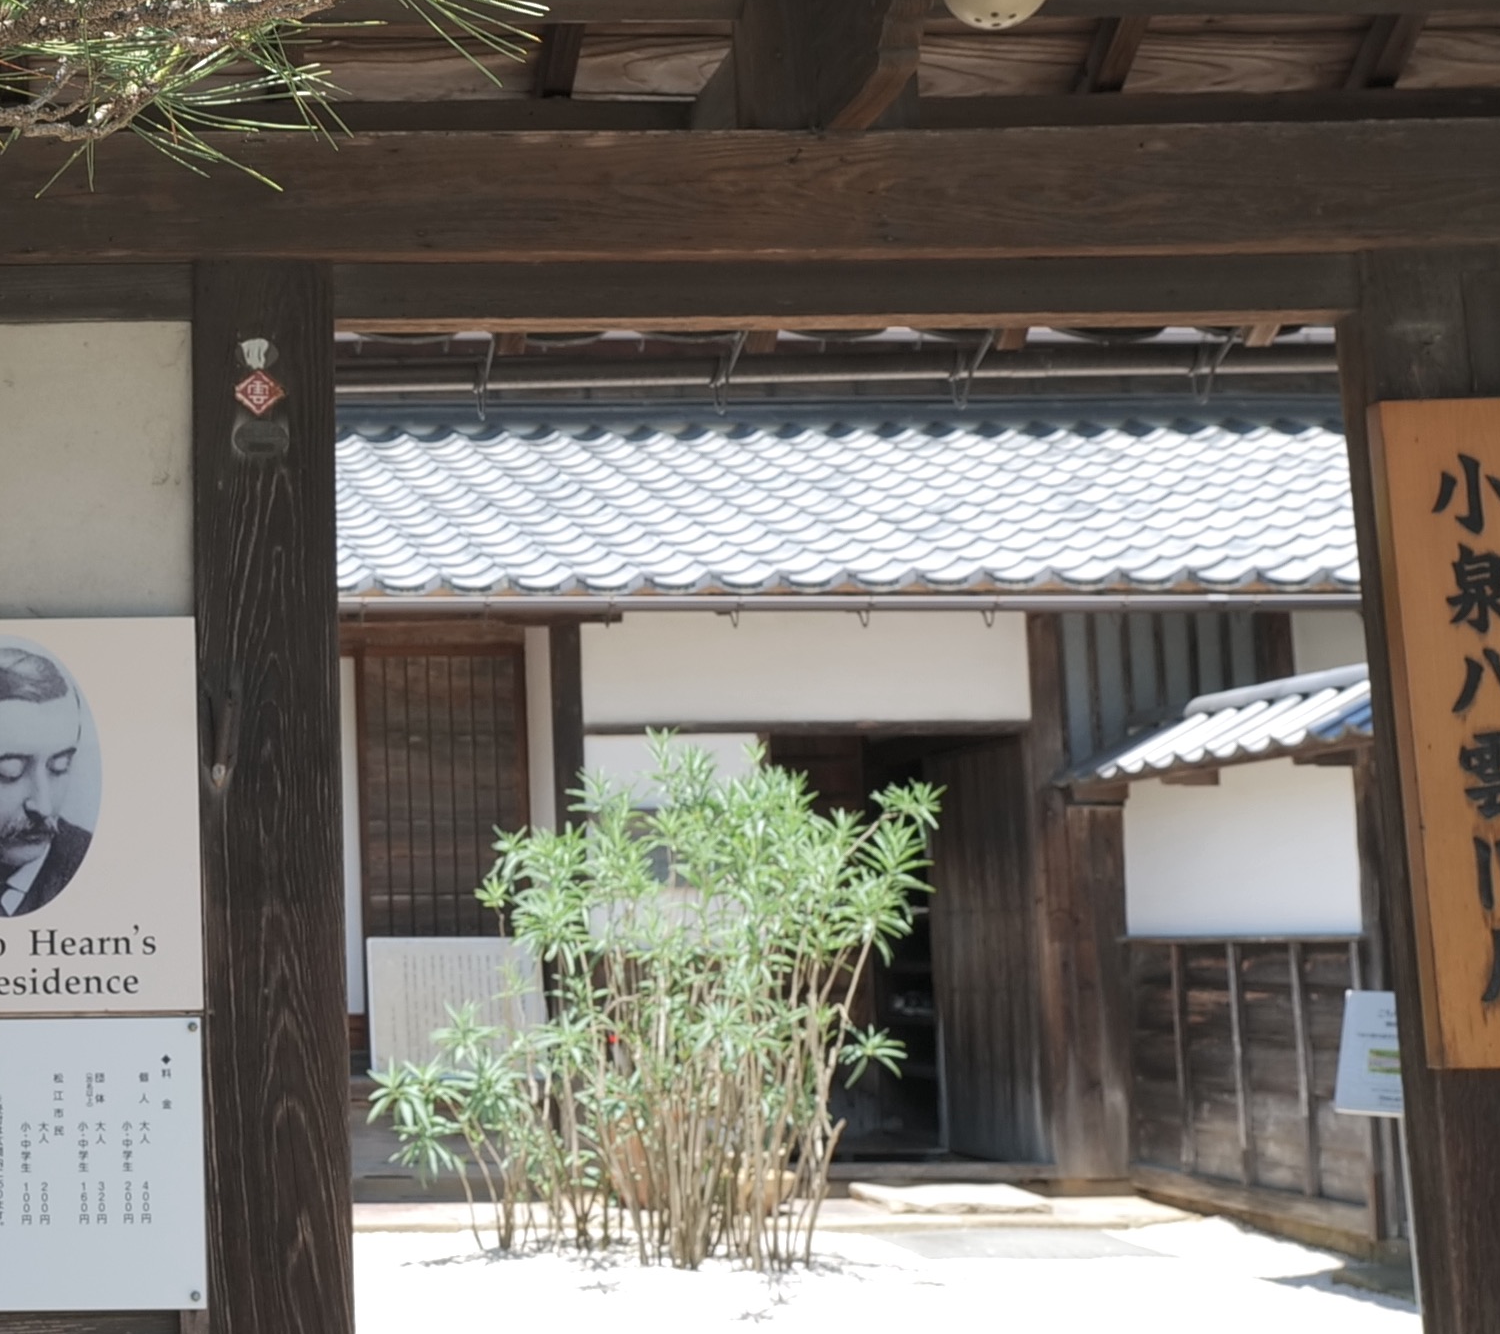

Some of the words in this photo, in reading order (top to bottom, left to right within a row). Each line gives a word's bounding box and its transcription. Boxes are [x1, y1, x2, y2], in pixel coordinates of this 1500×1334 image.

[30, 925, 156, 955] Hearn's
[53, 1073, 64, 1136] 松江市民
[95, 1073, 105, 1103] 団体
[139, 1072, 149, 1103] 個人
[161, 1069, 172, 1109] 料金
[21, 1122, 31, 1173] 小・中学生
[39, 1122, 49, 1143] 大人
[78, 1122, 88, 1172] 小・中学生
[96, 1121, 106, 1144] 大人
[122, 1121, 132, 1172] 小・中学生
[140, 1121, 150, 1144] 大人
[22, 1182, 32, 1225] 100円
[40, 1182, 50, 1225] 200円
[79, 1182, 89, 1224] 160円
[97, 1181, 107, 1224] 320円
[123, 1181, 134, 1224] 200円
[141, 1181, 151, 1224] 400円
